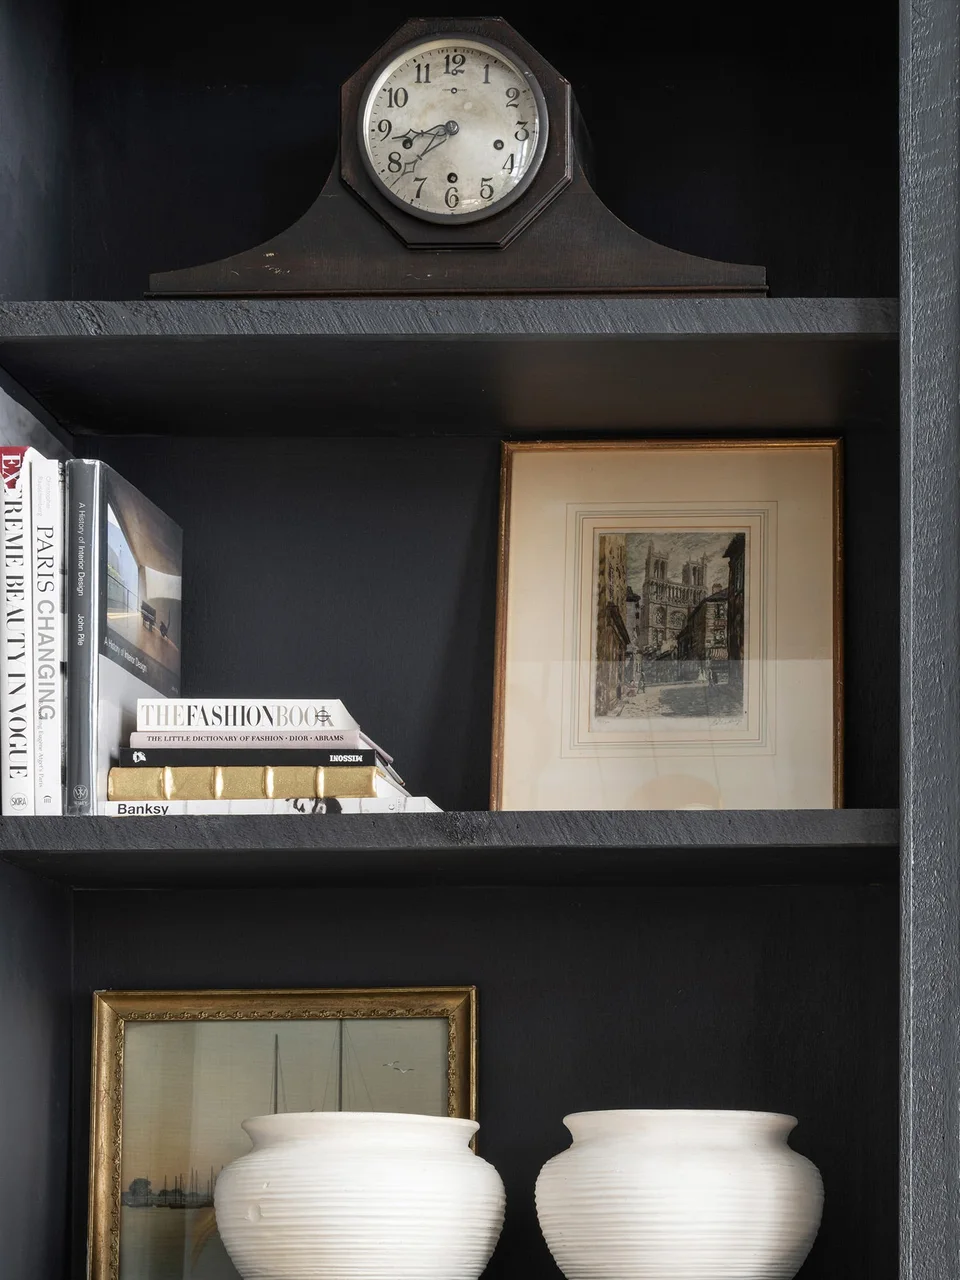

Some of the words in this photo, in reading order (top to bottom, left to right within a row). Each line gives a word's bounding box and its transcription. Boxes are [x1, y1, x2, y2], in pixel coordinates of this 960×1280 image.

[414, 63, 431, 84] 11
[443, 54, 466, 75] 12
[482, 63, 491, 84] 1
[387, 87, 409, 108] 10
[505, 87, 521, 108] 2
[378, 119, 392, 141] 9
[514, 121, 529, 141] 3
[387, 151, 402, 173] 8
[502, 153, 515, 174] 4
[413, 177, 427, 198] 7
[445, 187, 460, 208] 6
[480, 178, 494, 199] 5
[76, 511, 86, 535] History
[36, 526, 55, 593] PARIS
[77, 546, 86, 570] Interior
[76, 572, 86, 597] Design
[5, 573, 26, 669] BEAUTY
[77, 614, 86, 631] John
[77, 633, 86, 646] Pile
[36, 600, 56, 721] CHANGING
[6, 673, 27, 696] IN
[8, 703, 29, 779] VOGUE
[329, 754, 363, 762] MISSONI
[37, 773, 45, 788] Paris
[117, 803, 169, 815] Banksy
